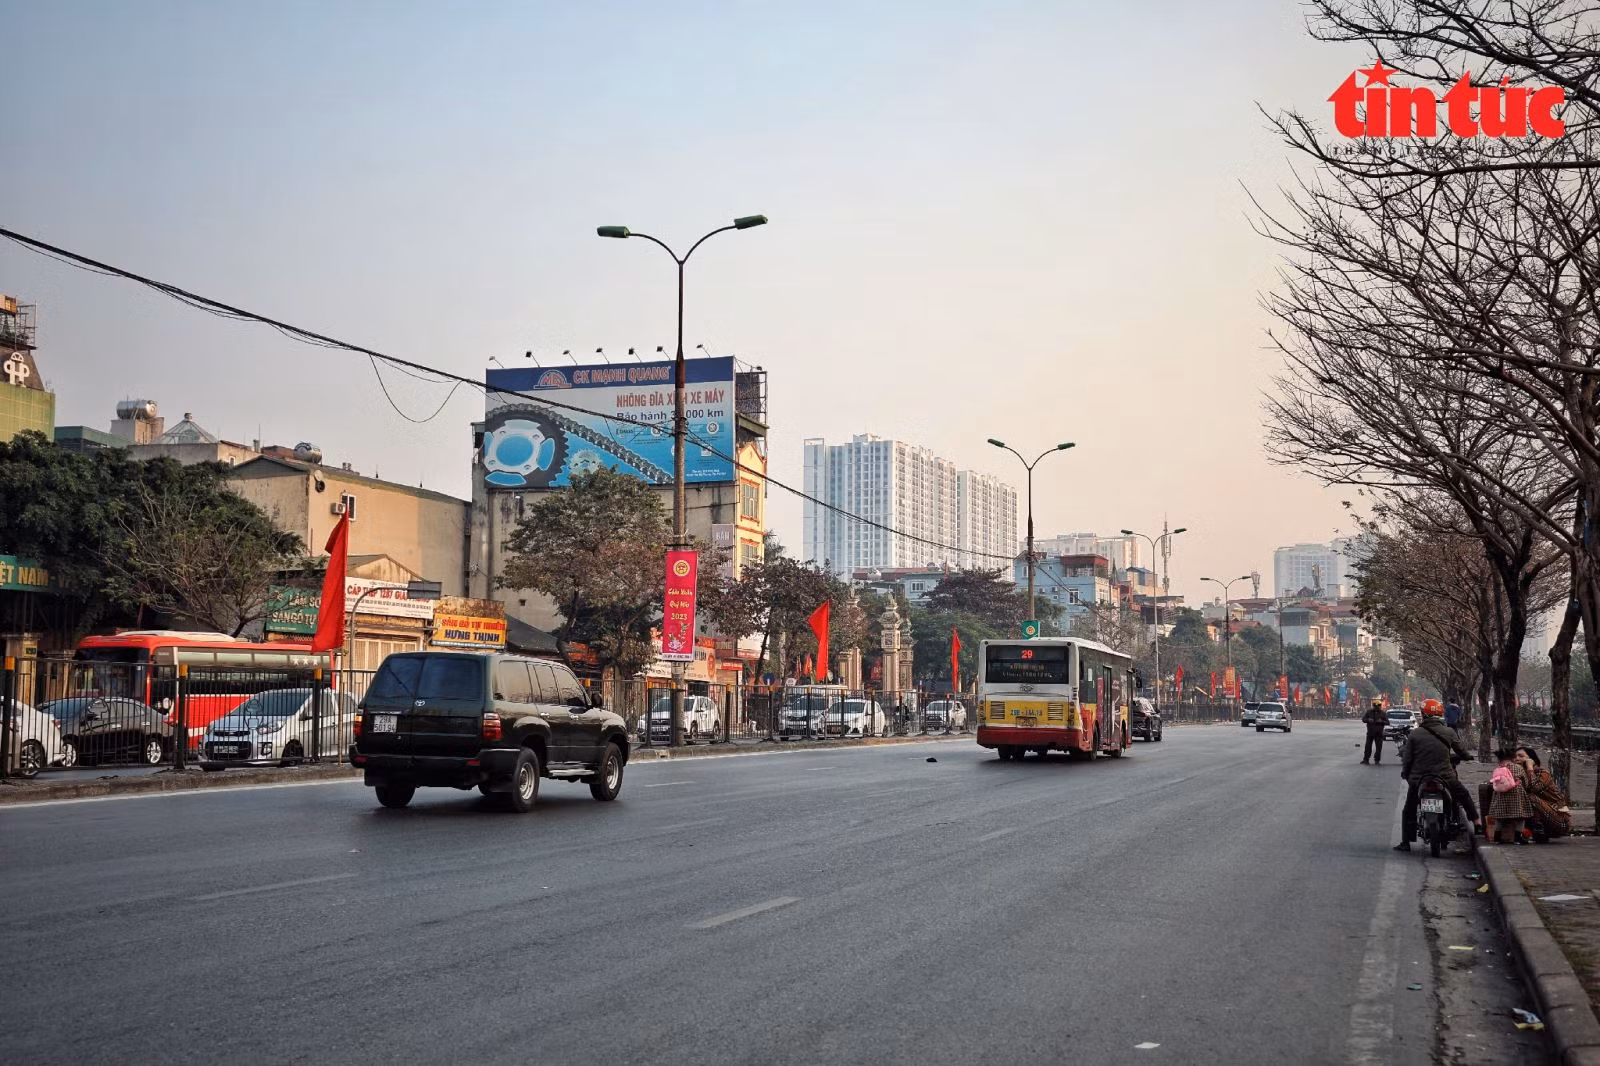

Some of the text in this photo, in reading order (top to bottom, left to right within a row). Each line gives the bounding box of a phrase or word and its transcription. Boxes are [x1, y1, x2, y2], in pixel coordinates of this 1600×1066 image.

[573, 370, 590, 384] CK
[690, 391, 702, 405] XE
[705, 388, 725, 404] MÁY
[707, 409, 724, 418] km
